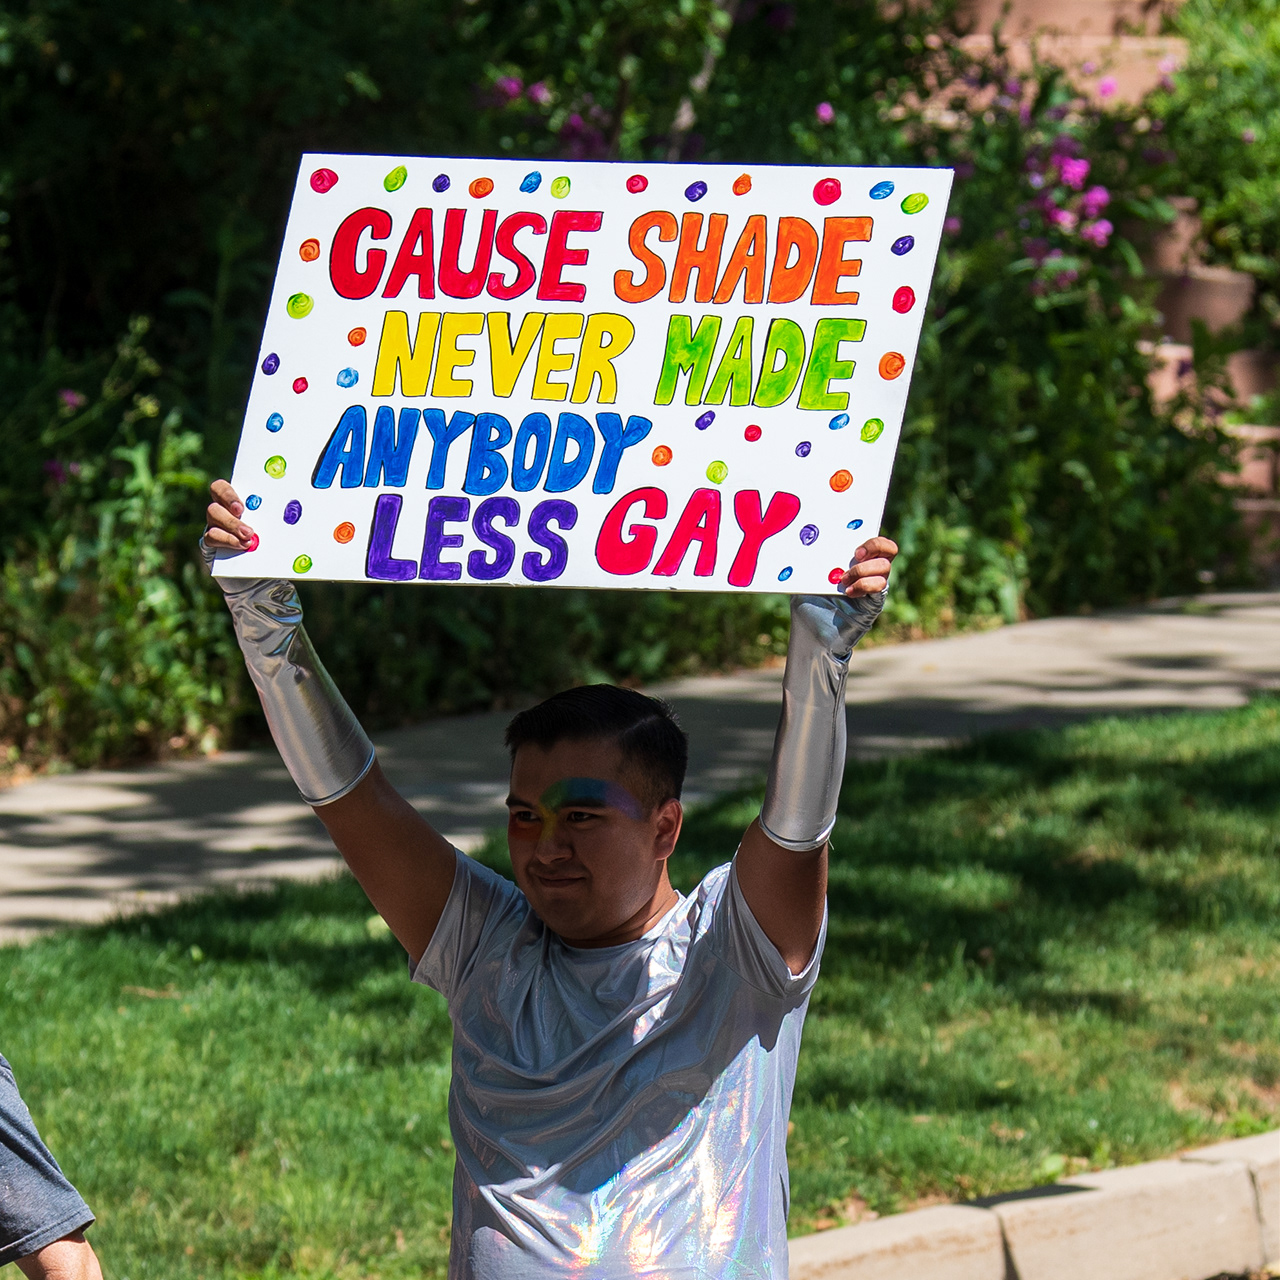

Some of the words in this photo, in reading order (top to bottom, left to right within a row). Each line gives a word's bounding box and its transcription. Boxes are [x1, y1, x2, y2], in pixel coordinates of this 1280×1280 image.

[613, 211, 874, 306] SHADE
[371, 311, 635, 404] NEVER
[654, 314, 867, 411] MADE
[310, 404, 653, 496] ANYBODY
[365, 494, 578, 582] LESS
[594, 487, 801, 588] GAY
